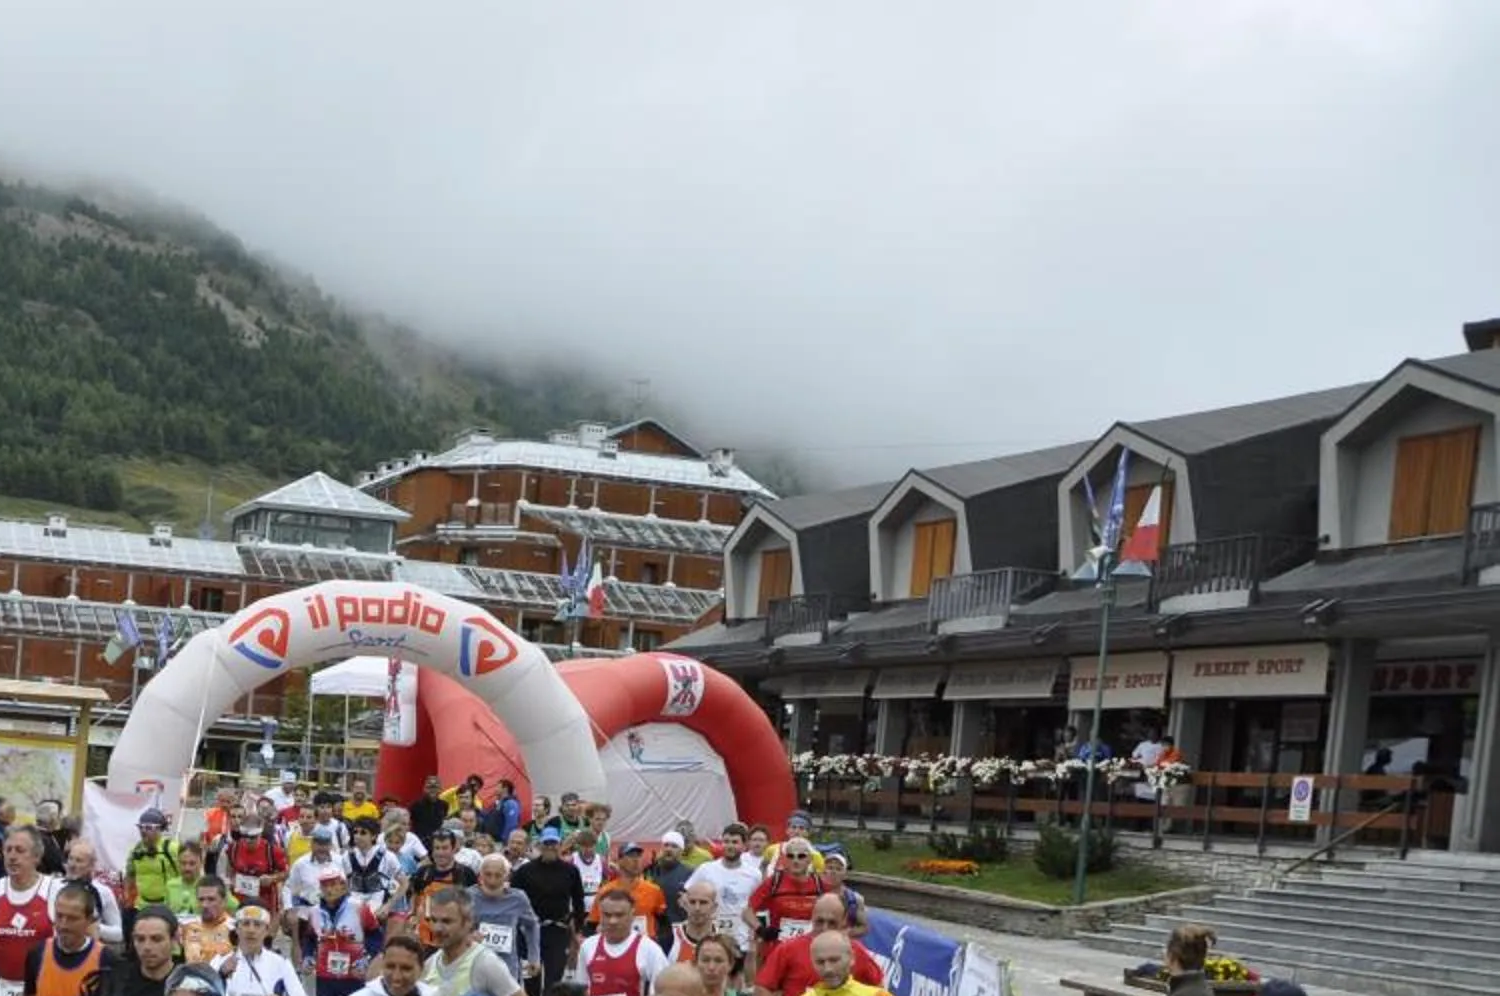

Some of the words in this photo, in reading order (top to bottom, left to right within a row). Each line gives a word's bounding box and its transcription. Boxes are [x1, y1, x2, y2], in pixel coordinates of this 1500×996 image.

[303, 594, 330, 630] il
[335, 591, 447, 636] podio
[1256, 657, 1305, 676] SPORT
